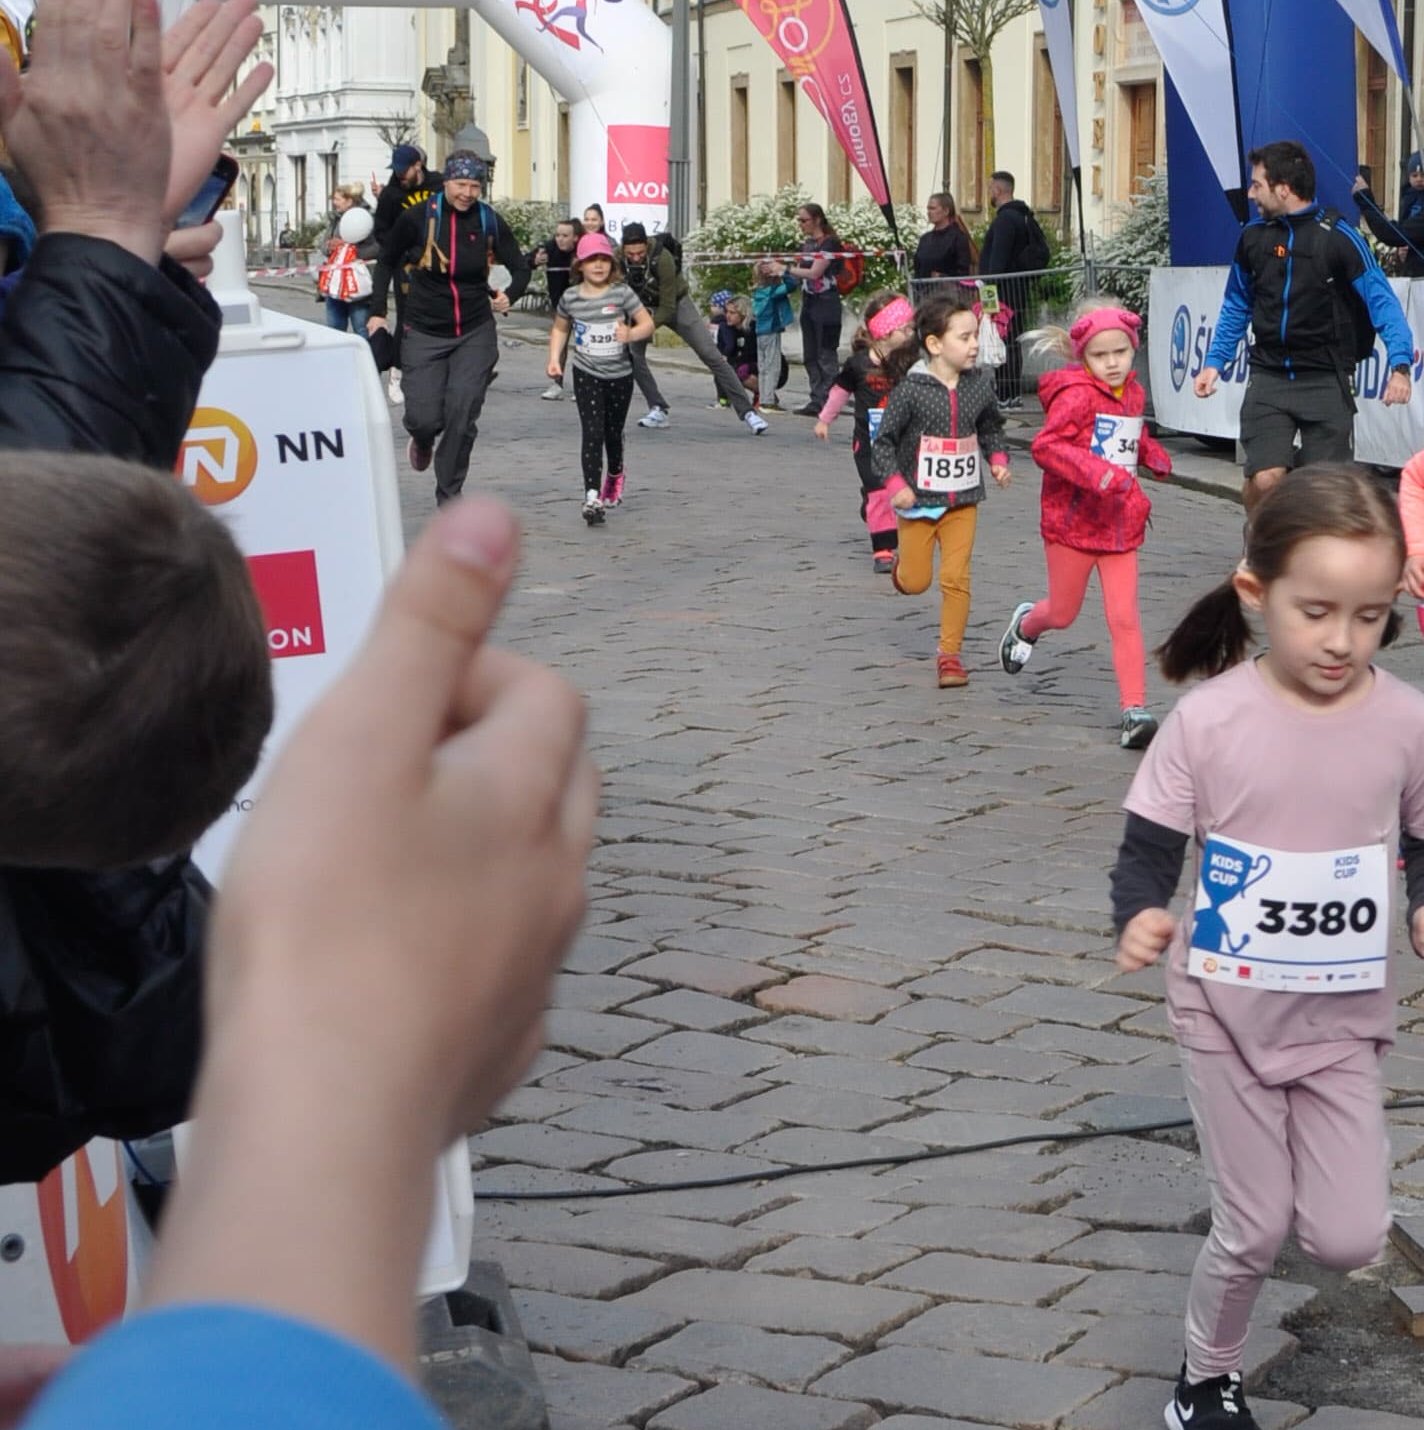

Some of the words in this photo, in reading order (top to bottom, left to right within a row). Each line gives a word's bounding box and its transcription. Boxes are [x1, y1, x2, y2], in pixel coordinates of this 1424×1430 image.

[276, 428, 345, 464] NN
[923, 455, 976, 479] 1859
[1210, 852, 1243, 873] KIDS
[1334, 854, 1361, 868] KIDS
[1208, 870, 1239, 887] CUP
[1333, 867, 1358, 879] CUP
[1255, 897, 1378, 937] 3380
